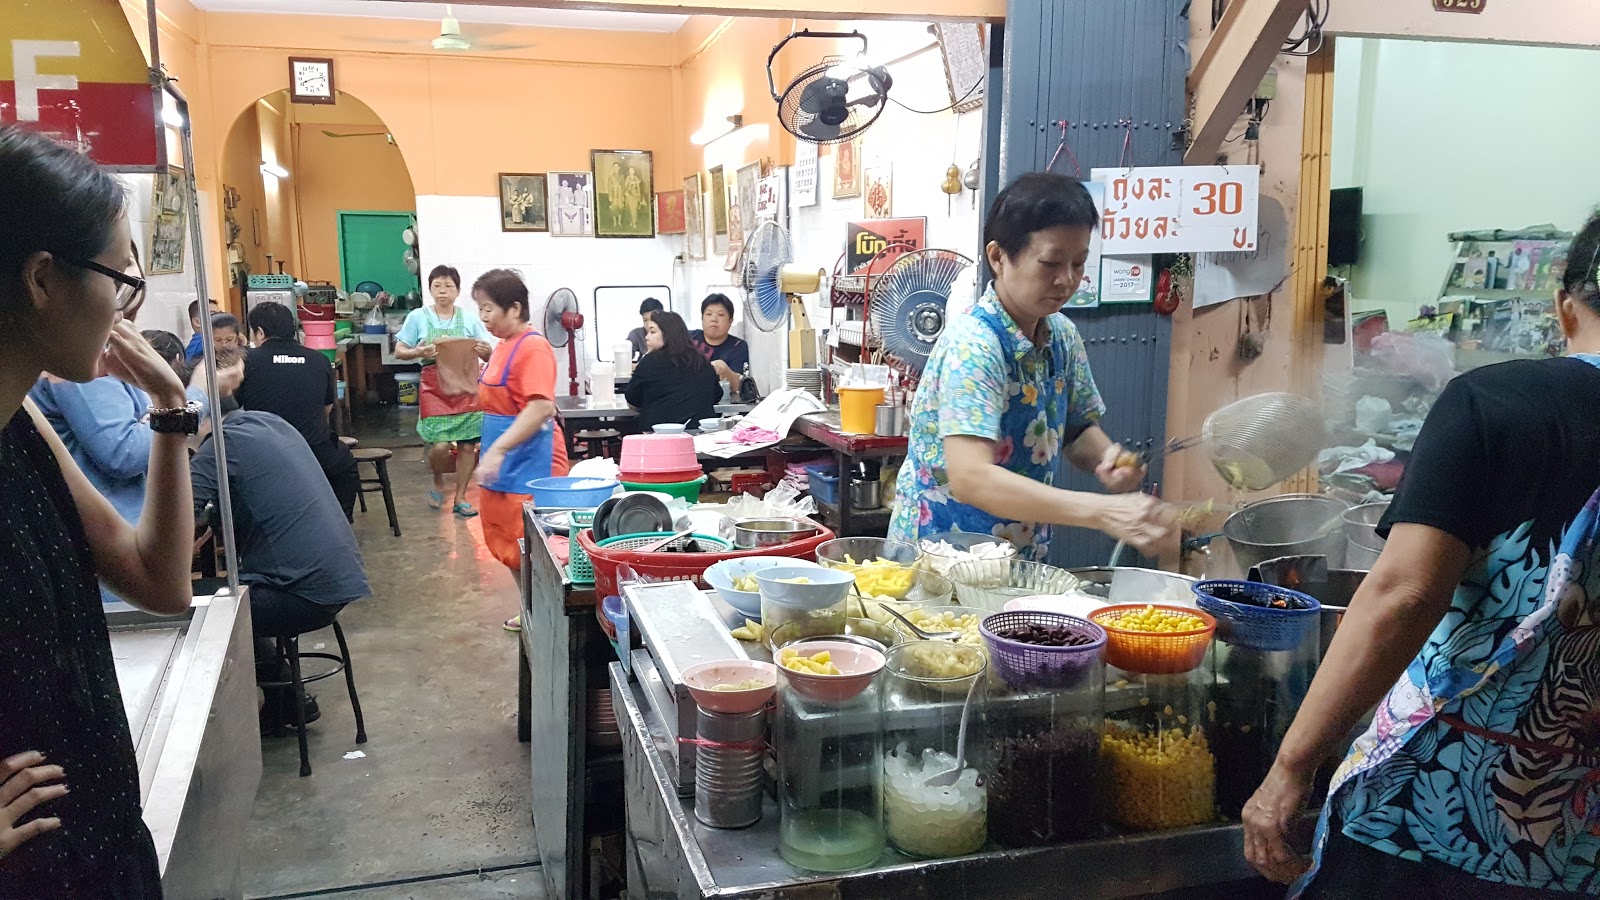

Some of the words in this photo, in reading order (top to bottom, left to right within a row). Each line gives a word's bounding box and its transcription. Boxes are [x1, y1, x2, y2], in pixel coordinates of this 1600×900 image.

[12, 39, 80, 121] F
[1113, 178, 1172, 210] ถุงละ
[1193, 181, 1243, 215] 30
[273, 355, 306, 364] Nikon
